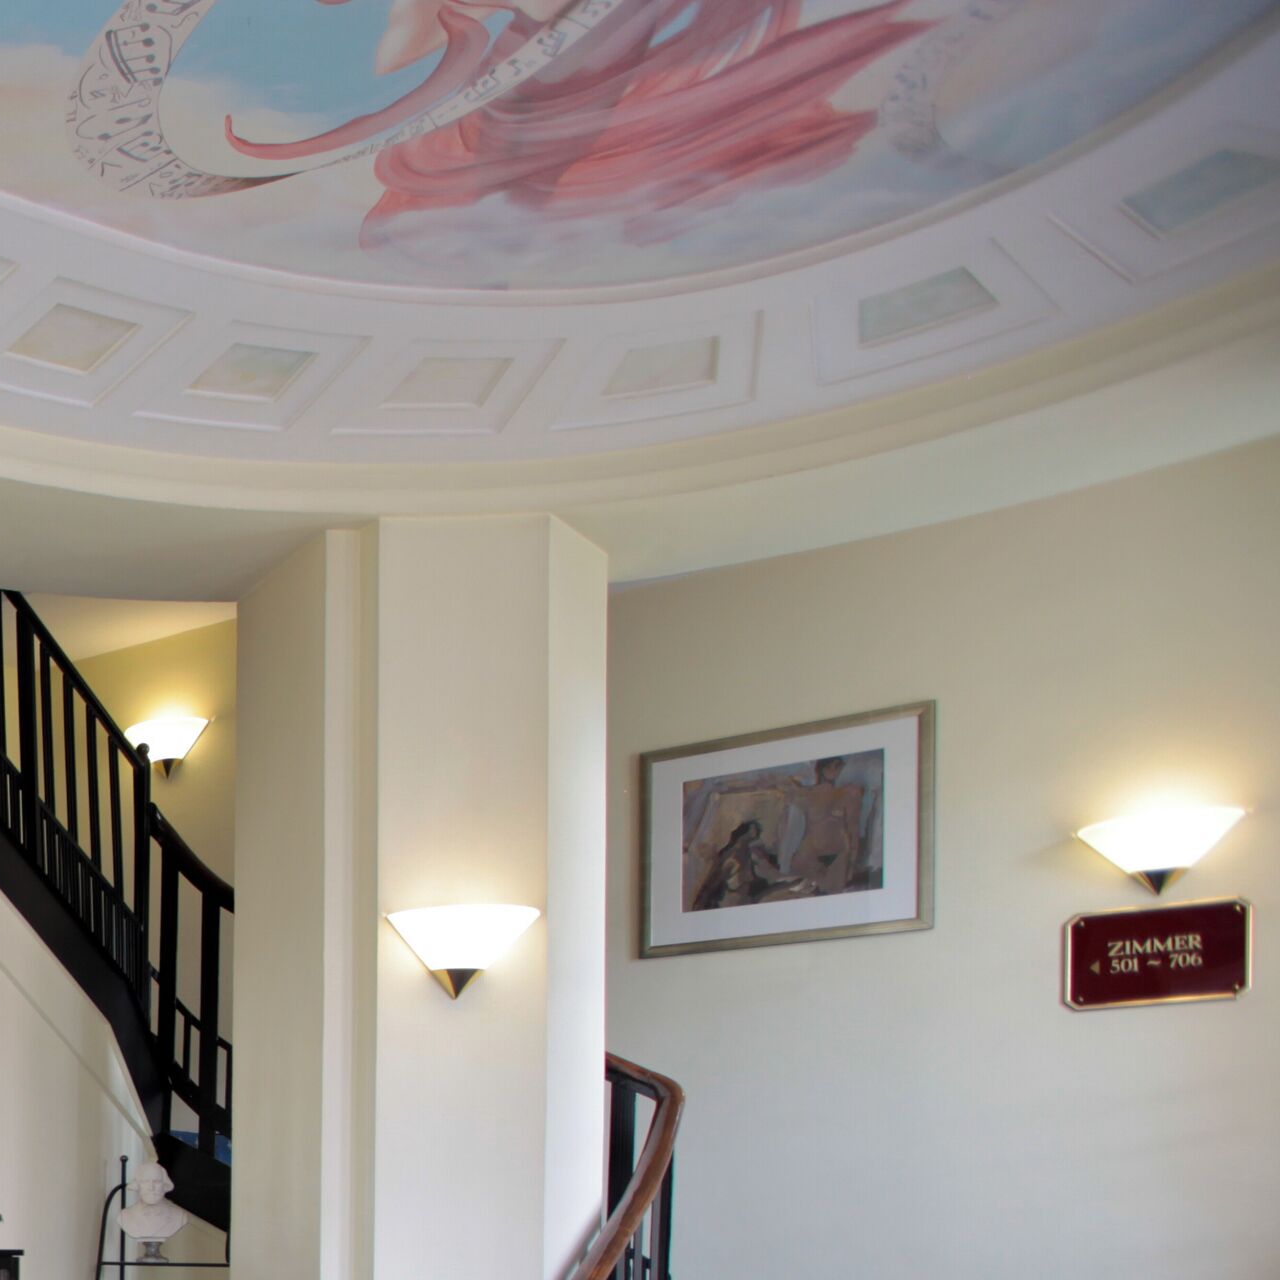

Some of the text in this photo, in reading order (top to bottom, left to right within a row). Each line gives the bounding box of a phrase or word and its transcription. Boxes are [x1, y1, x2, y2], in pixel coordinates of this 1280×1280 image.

[1107, 934, 1203, 957] ZIMMER
[1110, 958, 1139, 974] 501
[1169, 953, 1203, 969] 706
